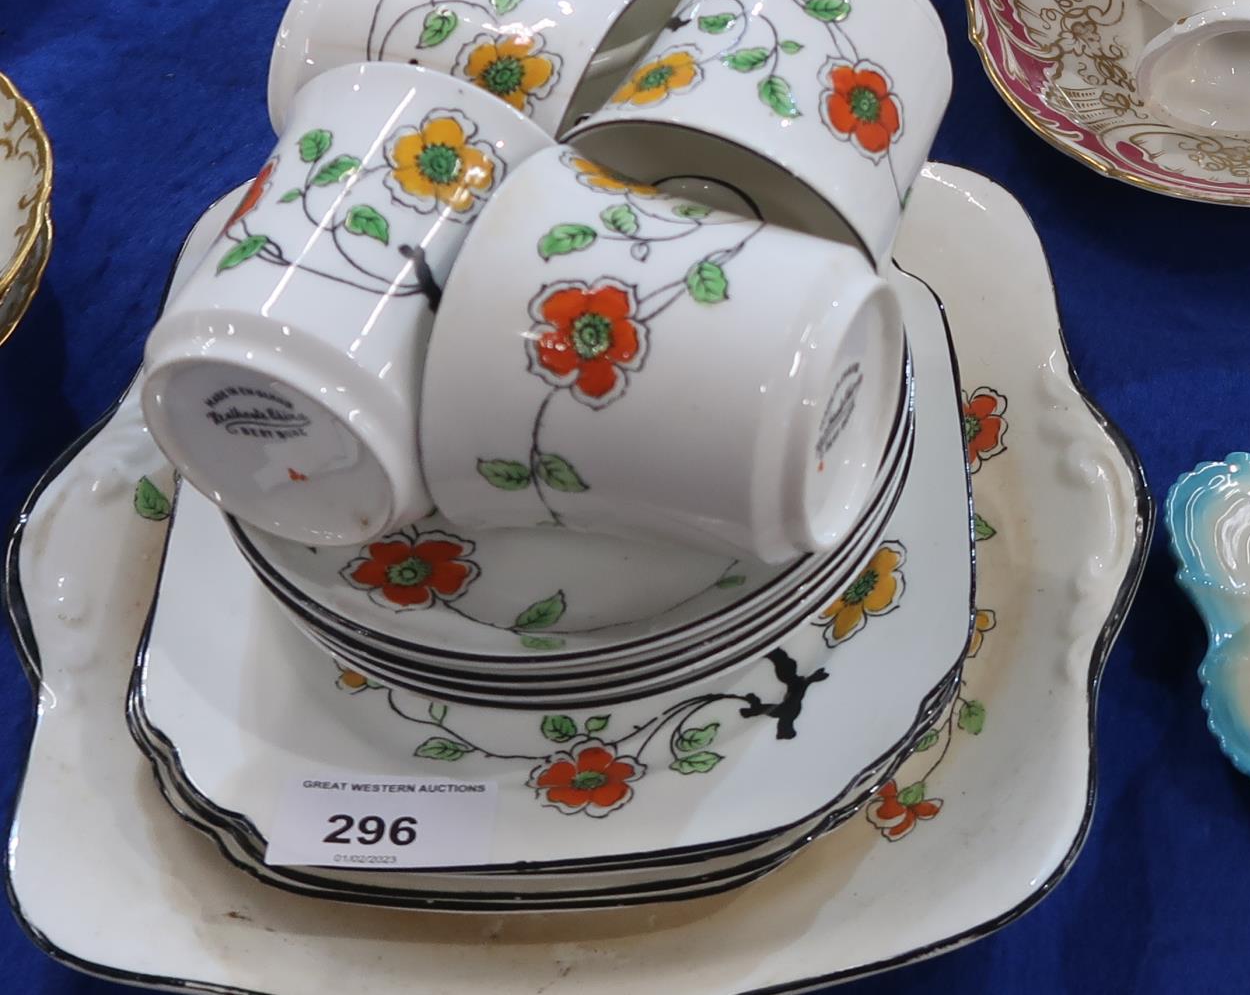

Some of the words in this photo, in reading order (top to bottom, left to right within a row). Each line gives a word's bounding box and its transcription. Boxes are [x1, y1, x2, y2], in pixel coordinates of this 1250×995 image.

[303, 780, 347, 791] GREAT
[351, 783, 416, 793] WESTERN
[419, 784, 486, 793] AUCTIONS
[323, 814, 418, 846] 296
[333, 853, 397, 864] 01/02/2023
